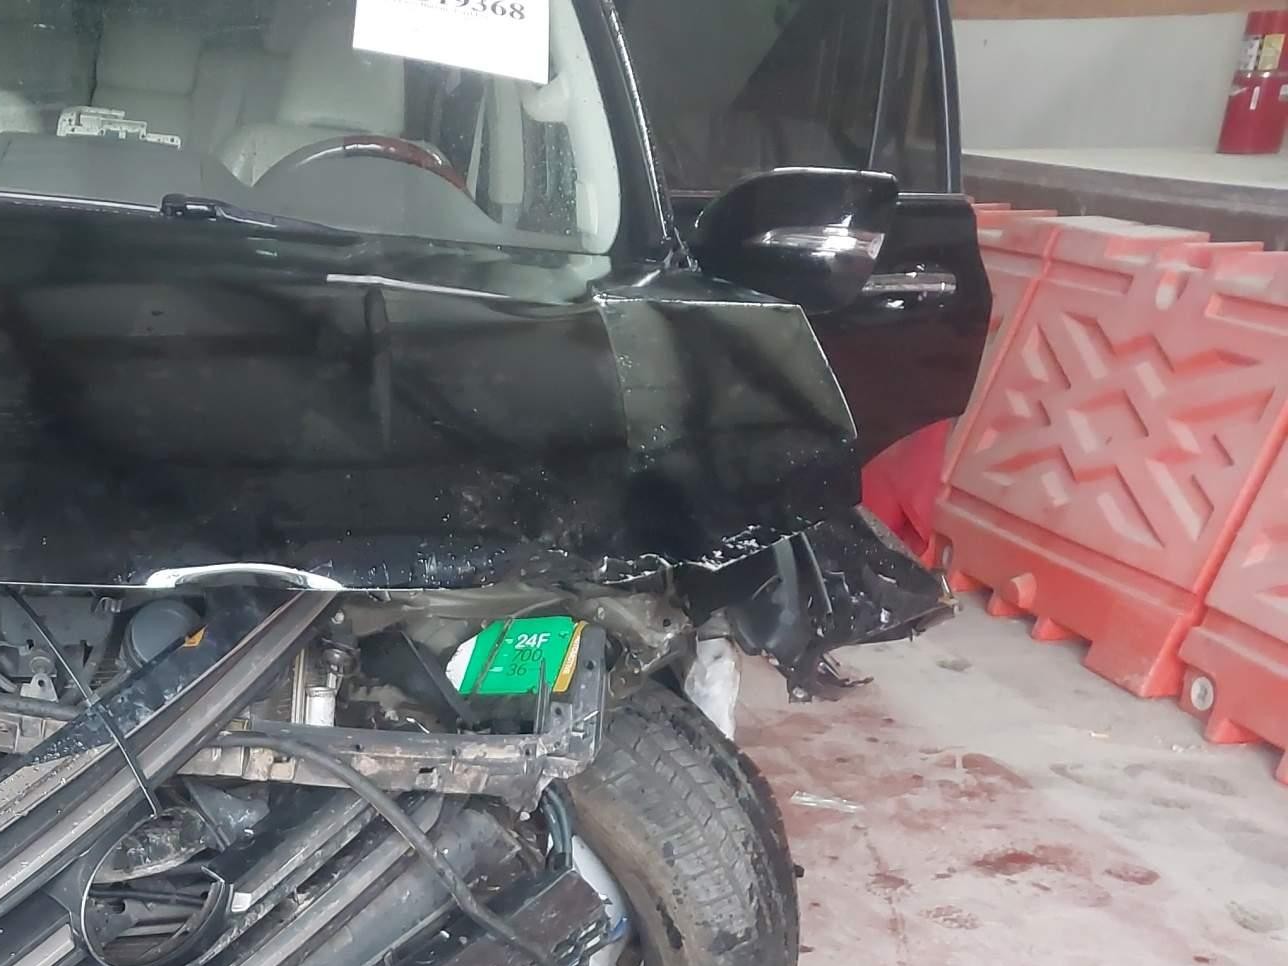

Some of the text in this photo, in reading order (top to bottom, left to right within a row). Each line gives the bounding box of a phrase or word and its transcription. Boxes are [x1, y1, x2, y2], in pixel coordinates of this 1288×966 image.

[514, 632, 551, 650] 24F
[513, 649, 543, 662] 700
[507, 663, 528, 677] 36
